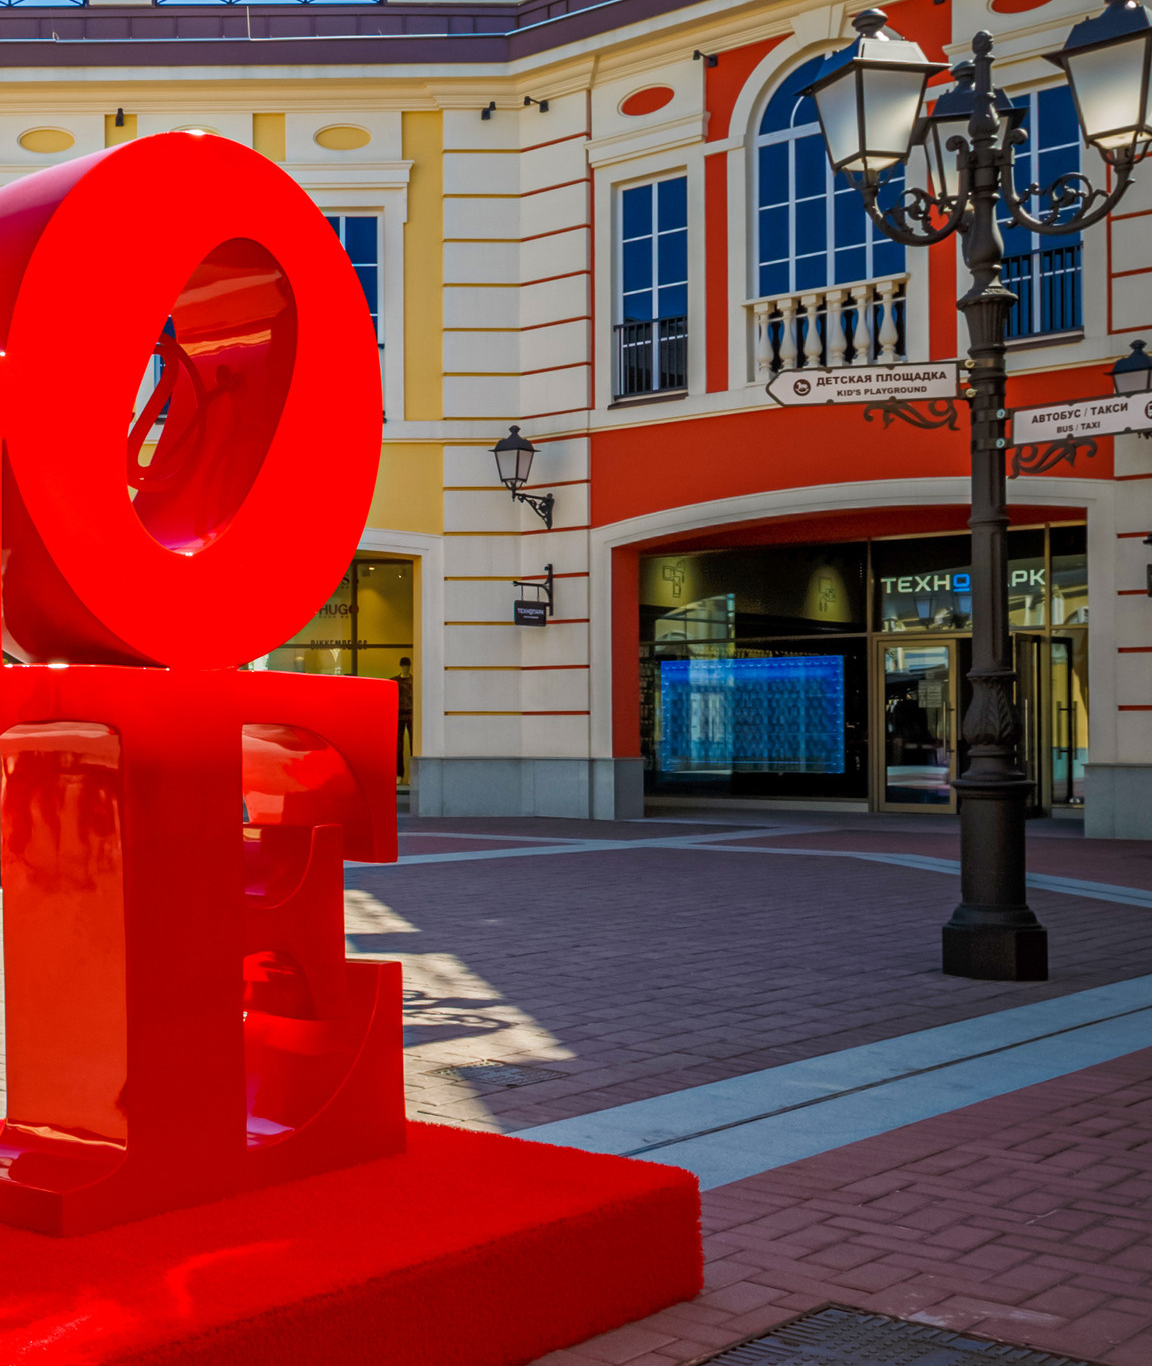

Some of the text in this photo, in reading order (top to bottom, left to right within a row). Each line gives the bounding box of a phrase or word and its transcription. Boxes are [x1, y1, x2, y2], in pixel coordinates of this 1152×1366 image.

[816, 371, 947, 387] ДЕТСКАЯ ПЛОЩАДКА
[836, 386, 928, 397] KID'S PLAYGROUND
[1031, 409, 1081, 424] АВТОБУС
[1090, 403, 1128, 416] ТАКСИ
[1056, 425, 1074, 433] BUS
[1081, 421, 1100, 430] TAXI
[880, 568, 1046, 594] ТЕХНОРК
